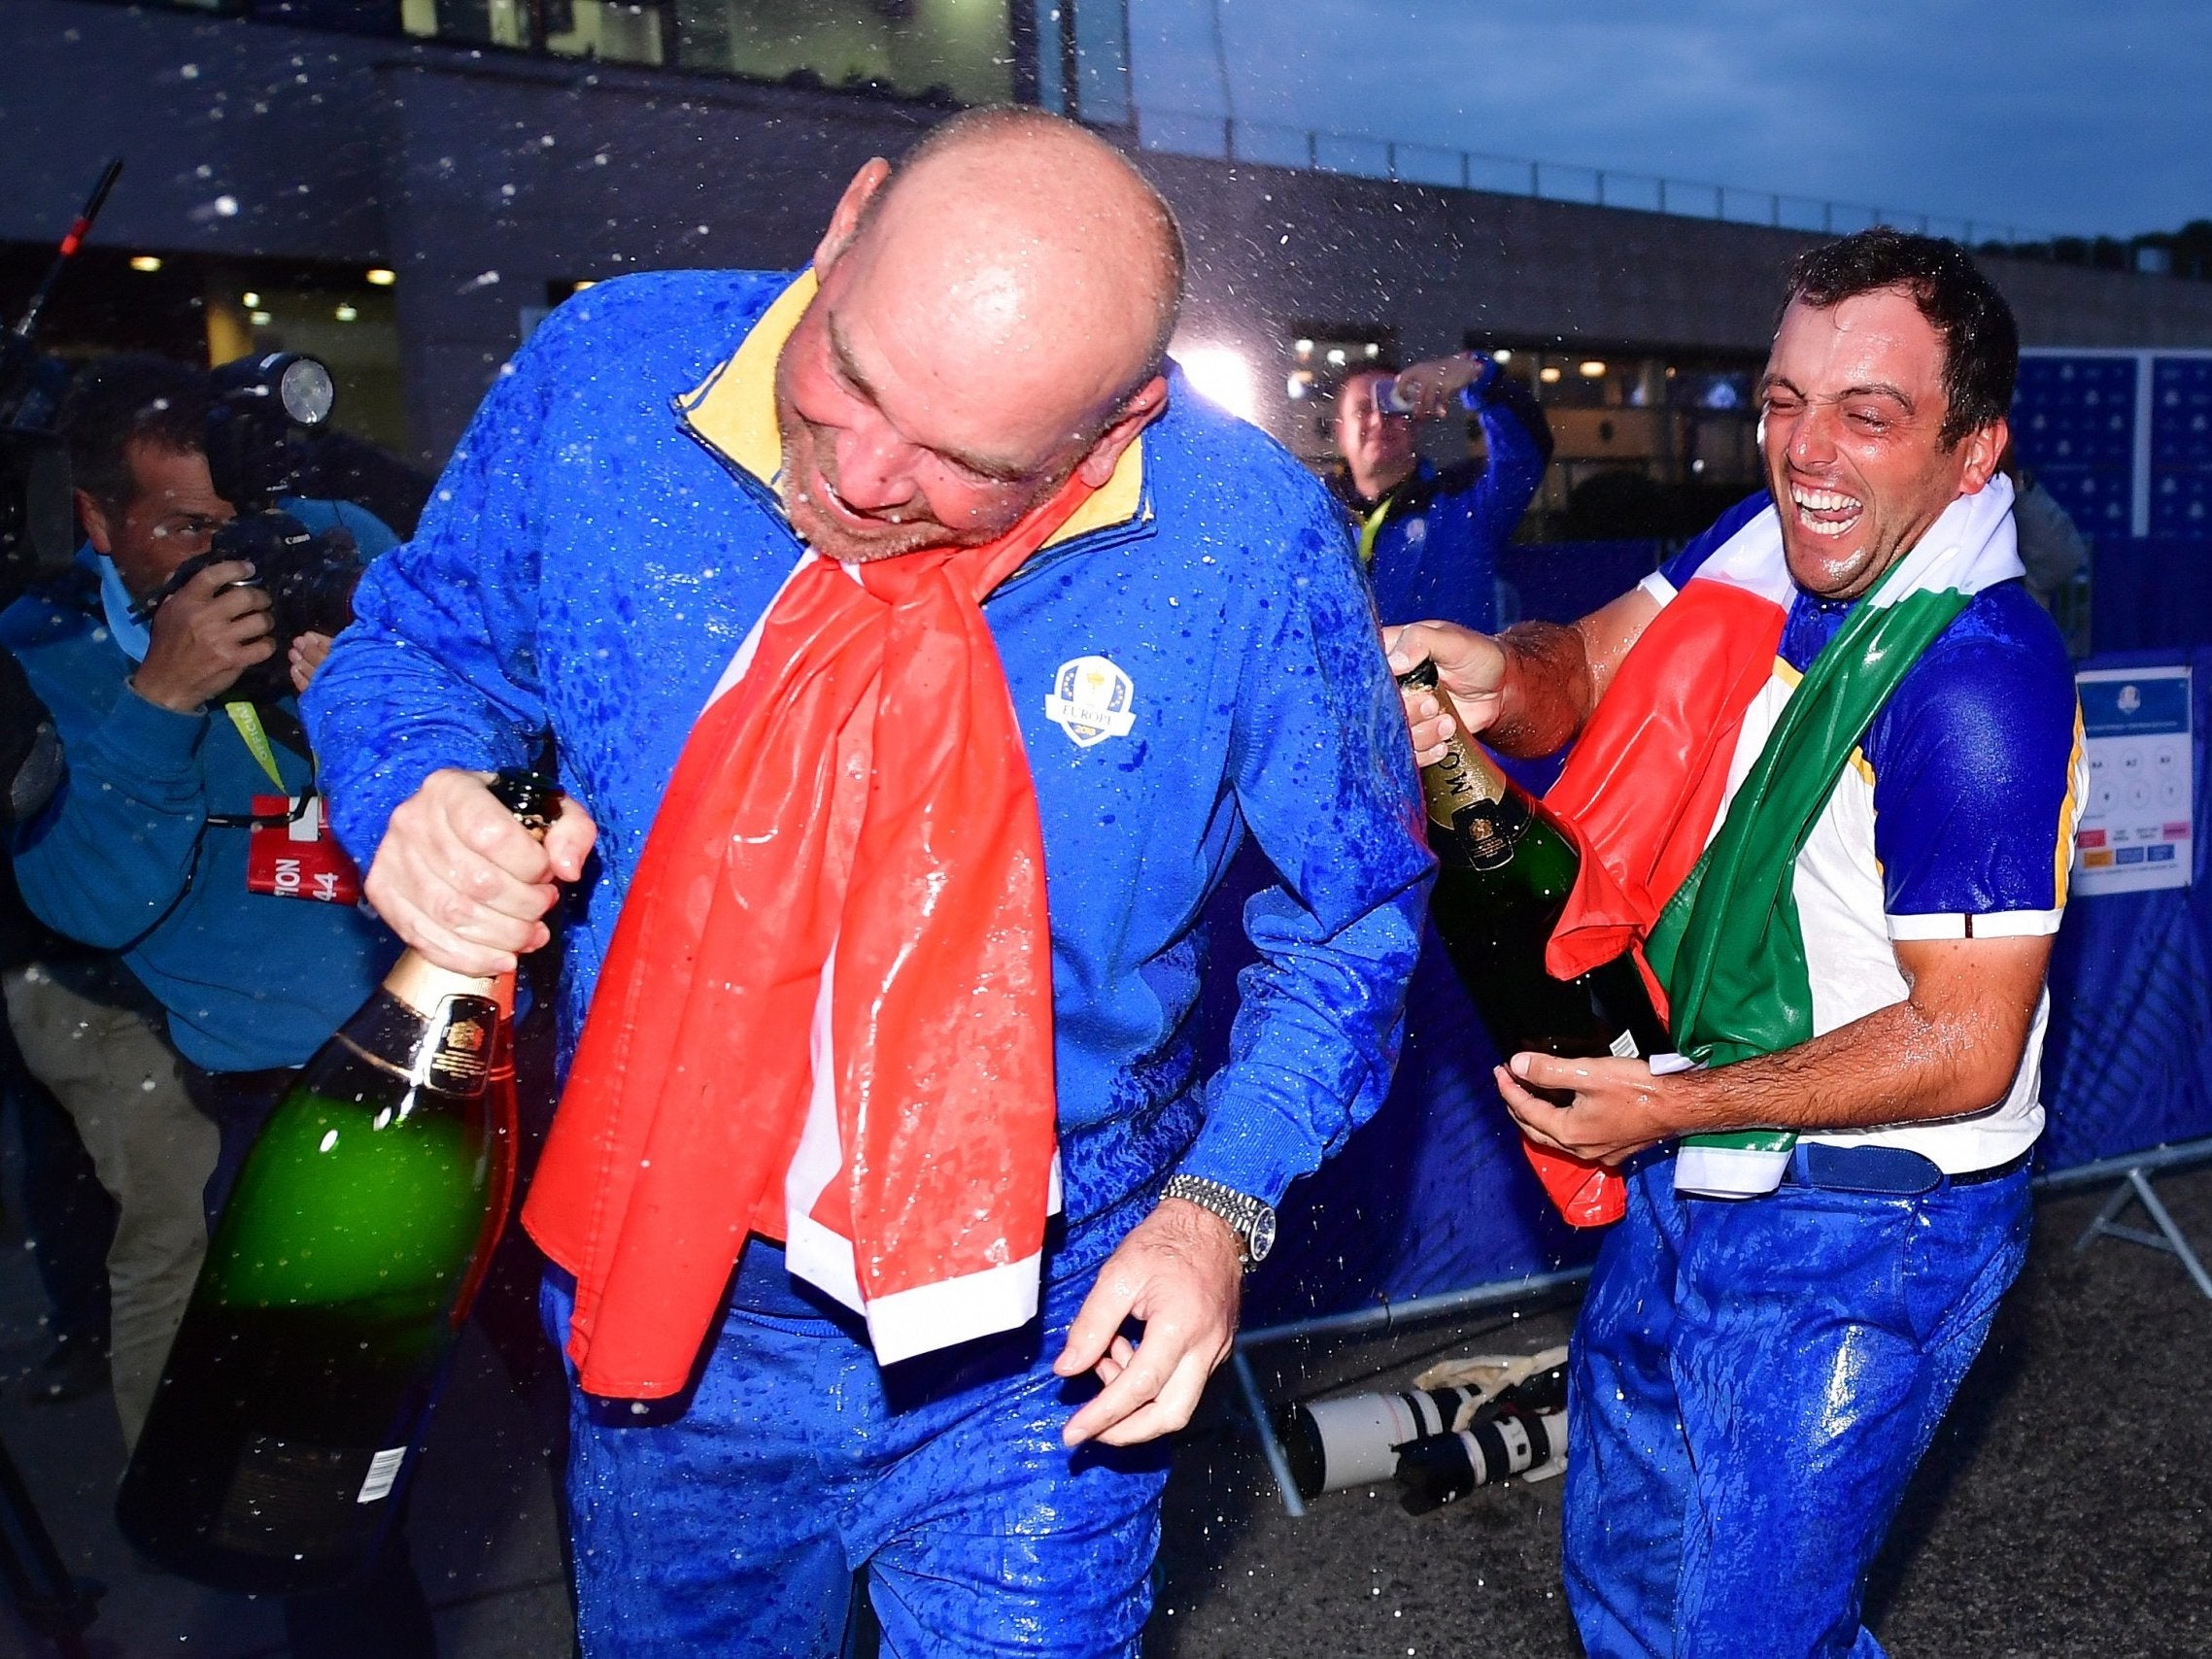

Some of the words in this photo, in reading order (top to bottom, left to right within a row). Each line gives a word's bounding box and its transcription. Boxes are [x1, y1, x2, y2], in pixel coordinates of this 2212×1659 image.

[285, 533, 311, 545] Canon
[236, 702, 269, 761] OFFICIAL
[1438, 741, 1475, 797] MO
[312, 872, 339, 901] 44
